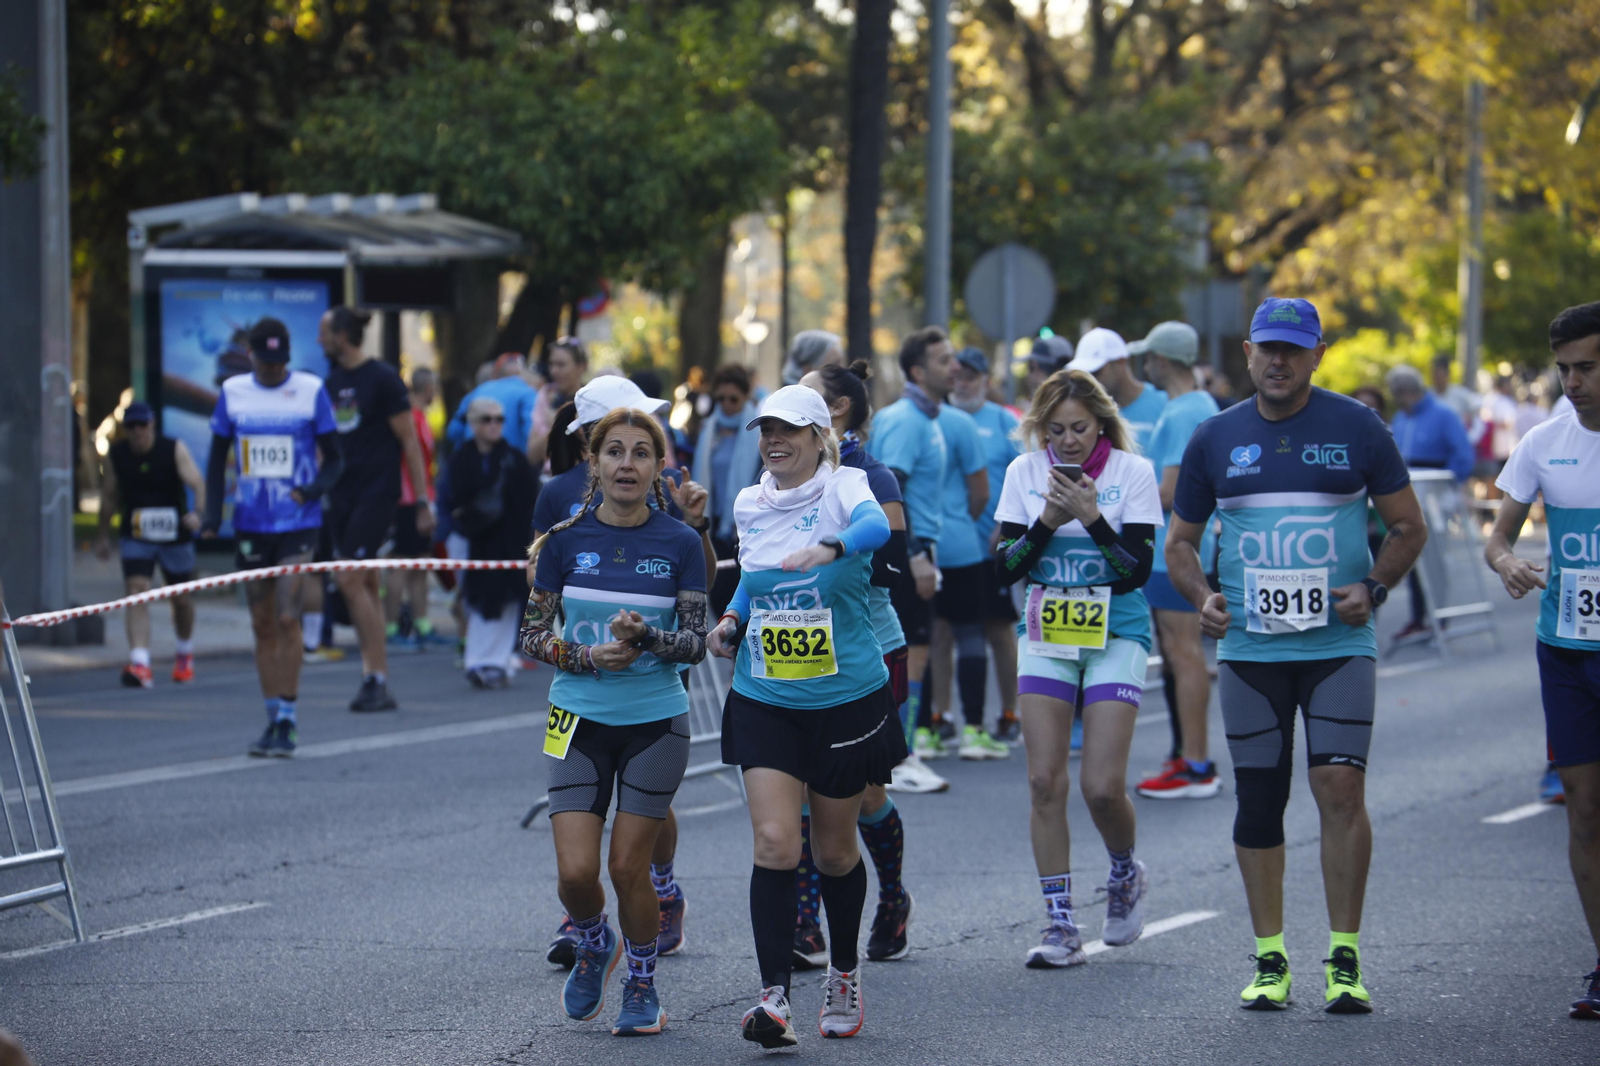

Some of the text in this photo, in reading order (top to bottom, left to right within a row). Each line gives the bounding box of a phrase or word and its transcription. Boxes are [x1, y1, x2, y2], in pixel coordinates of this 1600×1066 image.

[251, 448, 288, 463] 1103
[1238, 512, 1339, 568] aira
[1264, 575, 1299, 583] IMDECO
[1041, 600, 1103, 627] 5132
[1259, 588, 1323, 615] 3918
[1565, 596, 1573, 623] CAJÓN
[769, 614, 802, 622] IMDECO
[761, 628, 829, 657] 3632
[549, 704, 576, 734] 50
